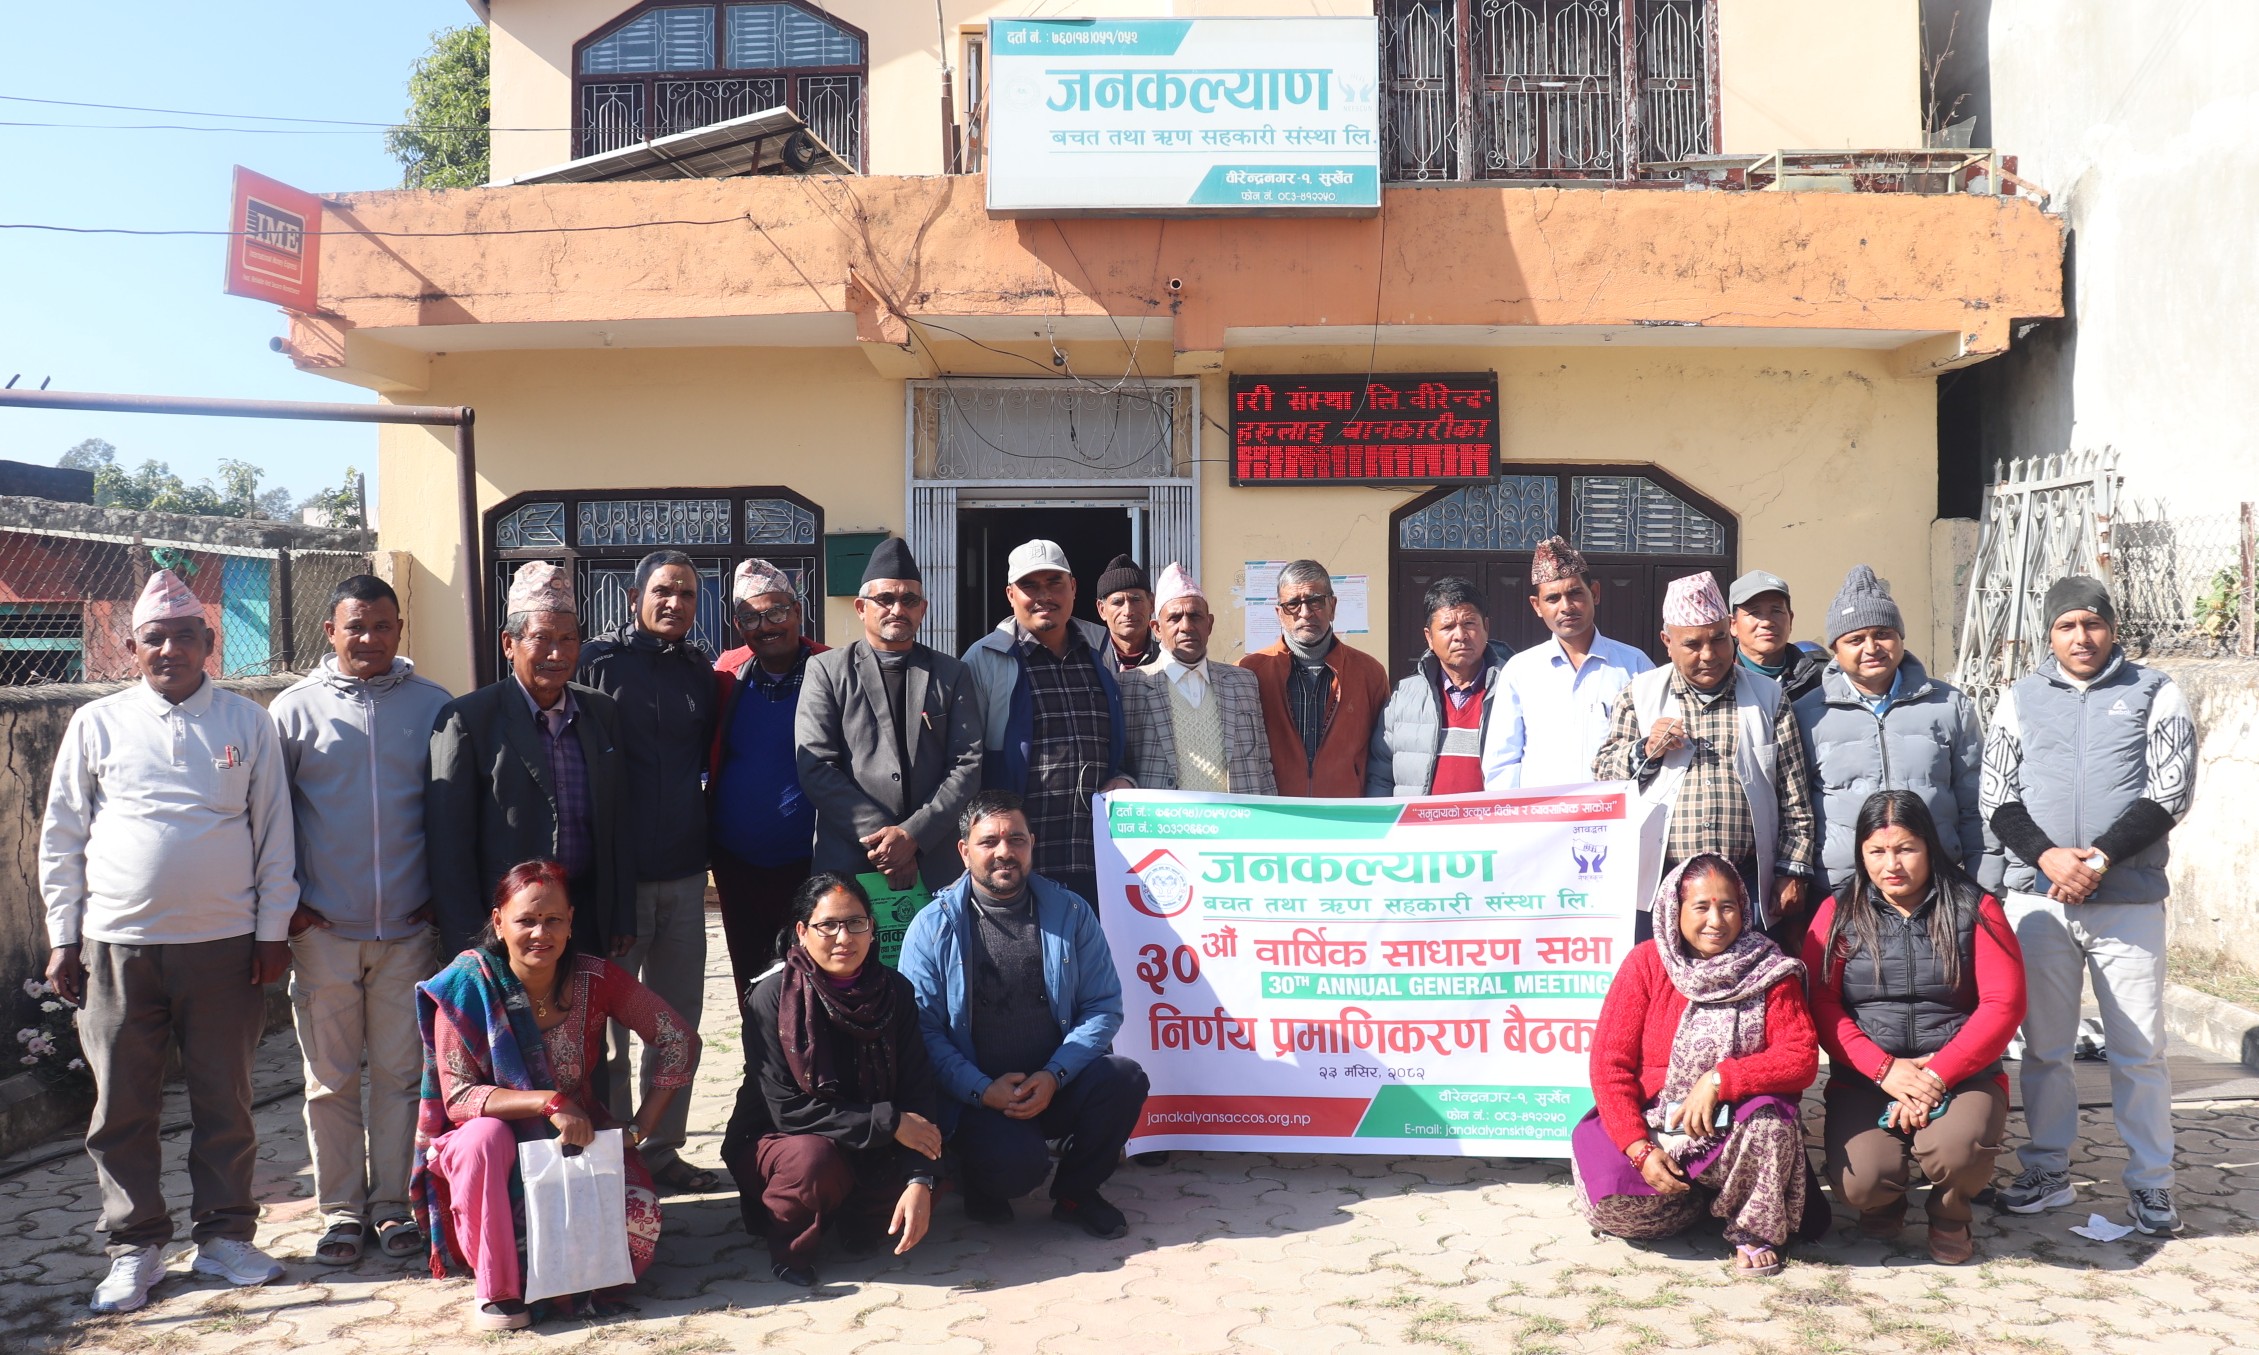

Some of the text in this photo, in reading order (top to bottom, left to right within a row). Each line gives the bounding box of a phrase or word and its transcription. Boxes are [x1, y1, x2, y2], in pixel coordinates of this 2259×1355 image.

[1007, 28, 1026, 45] दर्ता
[1045, 69, 1333, 114] जनकल्याण
[1049, 124, 1377, 147] बचत तथा ऋण सहकारी संस्था लि.
[1319, 170, 1354, 187] सुर्खेत
[1241, 189, 1260, 201] फोन
[256, 212, 299, 254] IME
[1285, 386, 1354, 411] संस्था
[1115, 803, 1133, 817] दर्ता
[1521, 805, 1528, 816] र
[1117, 822, 1135, 834] पान
[1199, 850, 1497, 887] जनकल्याण
[1202, 888, 1594, 915] बचत तथा ऋण सहकारी संस्था लि.
[1253, 926, 1368, 968] वार्षिक
[1381, 938, 1521, 967] साधारण
[1536, 936, 1613, 965] सभा
[1268, 974, 1610, 996] 30TH ANNUAL GENERAL MEETING
[1148, 1002, 1600, 1058] निर्णय प्रमाणिकरण बैठक
[1319, 1066, 1338, 1080] २३
[1387, 1067, 1425, 1081] २०८२
[1533, 1089, 1571, 1107] सुर्खेत
[1147, 1111, 1311, 1127] janakalyansaccos.org.np
[1446, 1107, 1469, 1121] फोन
[1404, 1123, 1572, 1139] E-mail: janakalyanskt@gmail.
